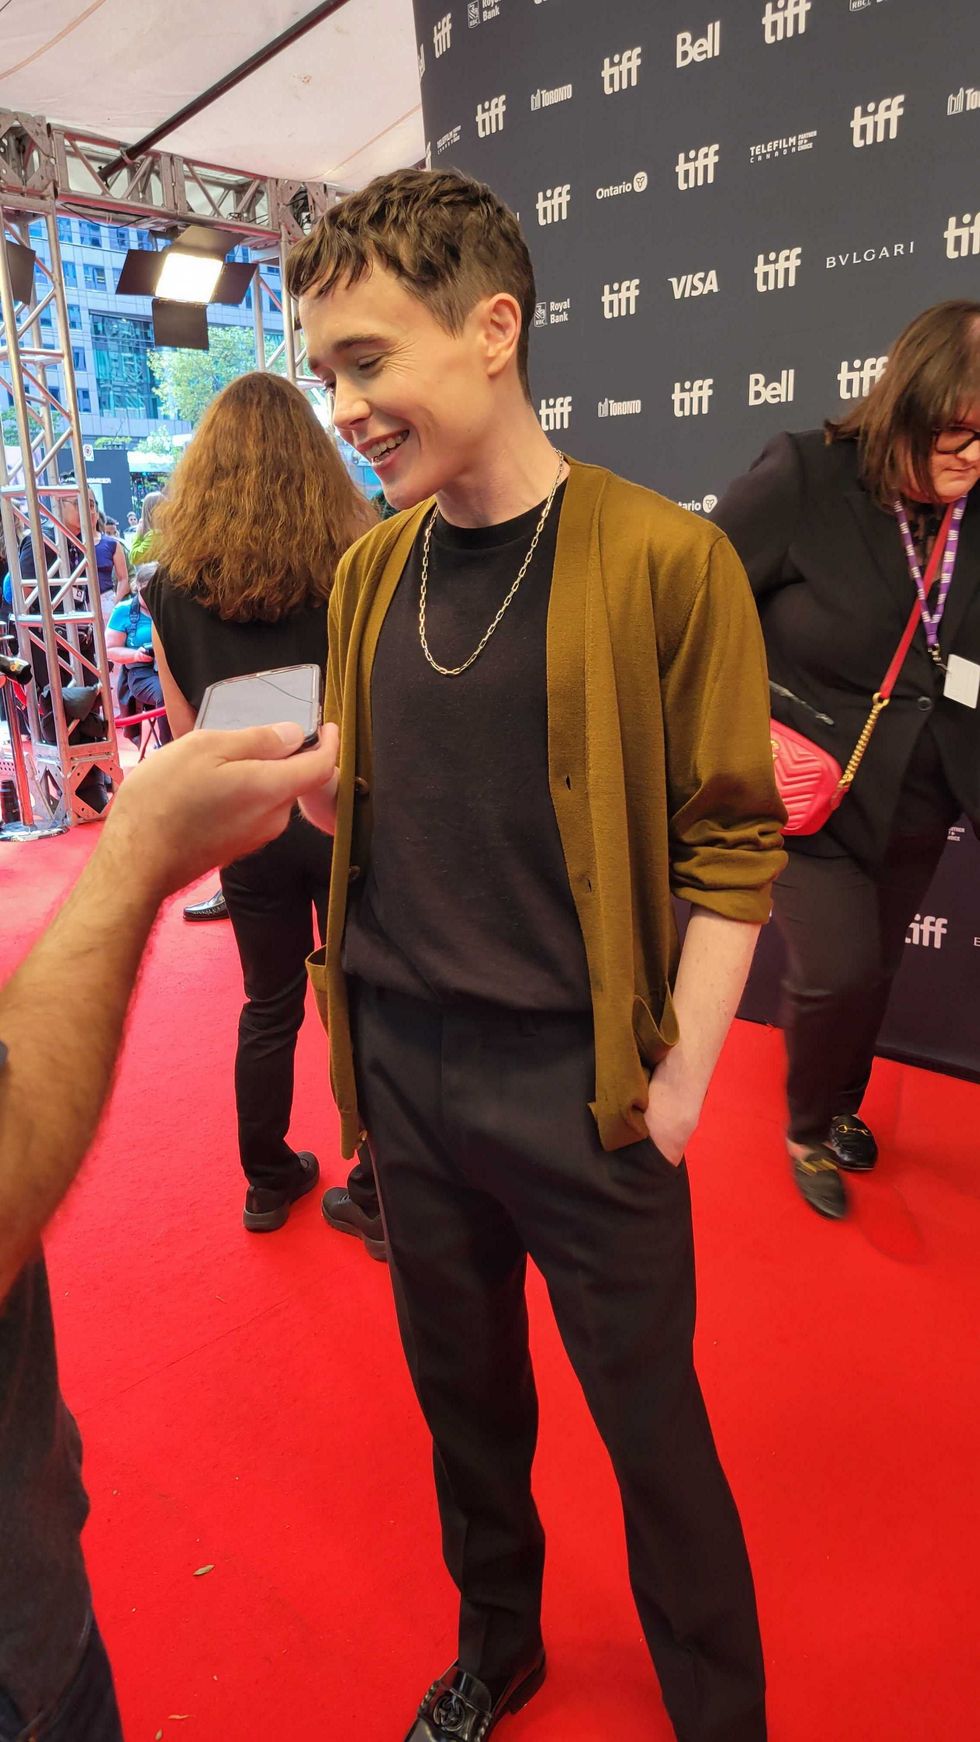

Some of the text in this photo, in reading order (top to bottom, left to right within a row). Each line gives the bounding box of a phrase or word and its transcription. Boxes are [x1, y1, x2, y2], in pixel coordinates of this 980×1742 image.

[482, 5, 500, 22] Bank
[762, 0, 811, 44] tiff
[433, 12, 452, 58] tiff
[676, 20, 721, 68] Bell
[601, 47, 642, 95] tiff
[475, 95, 506, 138] tiff
[850, 95, 905, 148] tiff
[750, 136, 797, 157] TELEFILM
[676, 144, 719, 190] tiff
[536, 184, 571, 226] tiff
[596, 182, 633, 200] Ontario
[826, 241, 915, 268] BVLGARI
[944, 212, 980, 259] tif
[668, 270, 719, 299] VISA
[754, 247, 802, 293] tiff
[550, 298, 571, 312] Royal
[550, 311, 568, 324] Bank
[601, 279, 640, 319] tiff
[672, 378, 713, 417] tiff
[749, 369, 795, 406] Bell
[837, 356, 889, 400] tiff
[539, 396, 572, 431] tiff
[608, 400, 642, 416] TORONTO
[905, 913, 949, 949] iff
